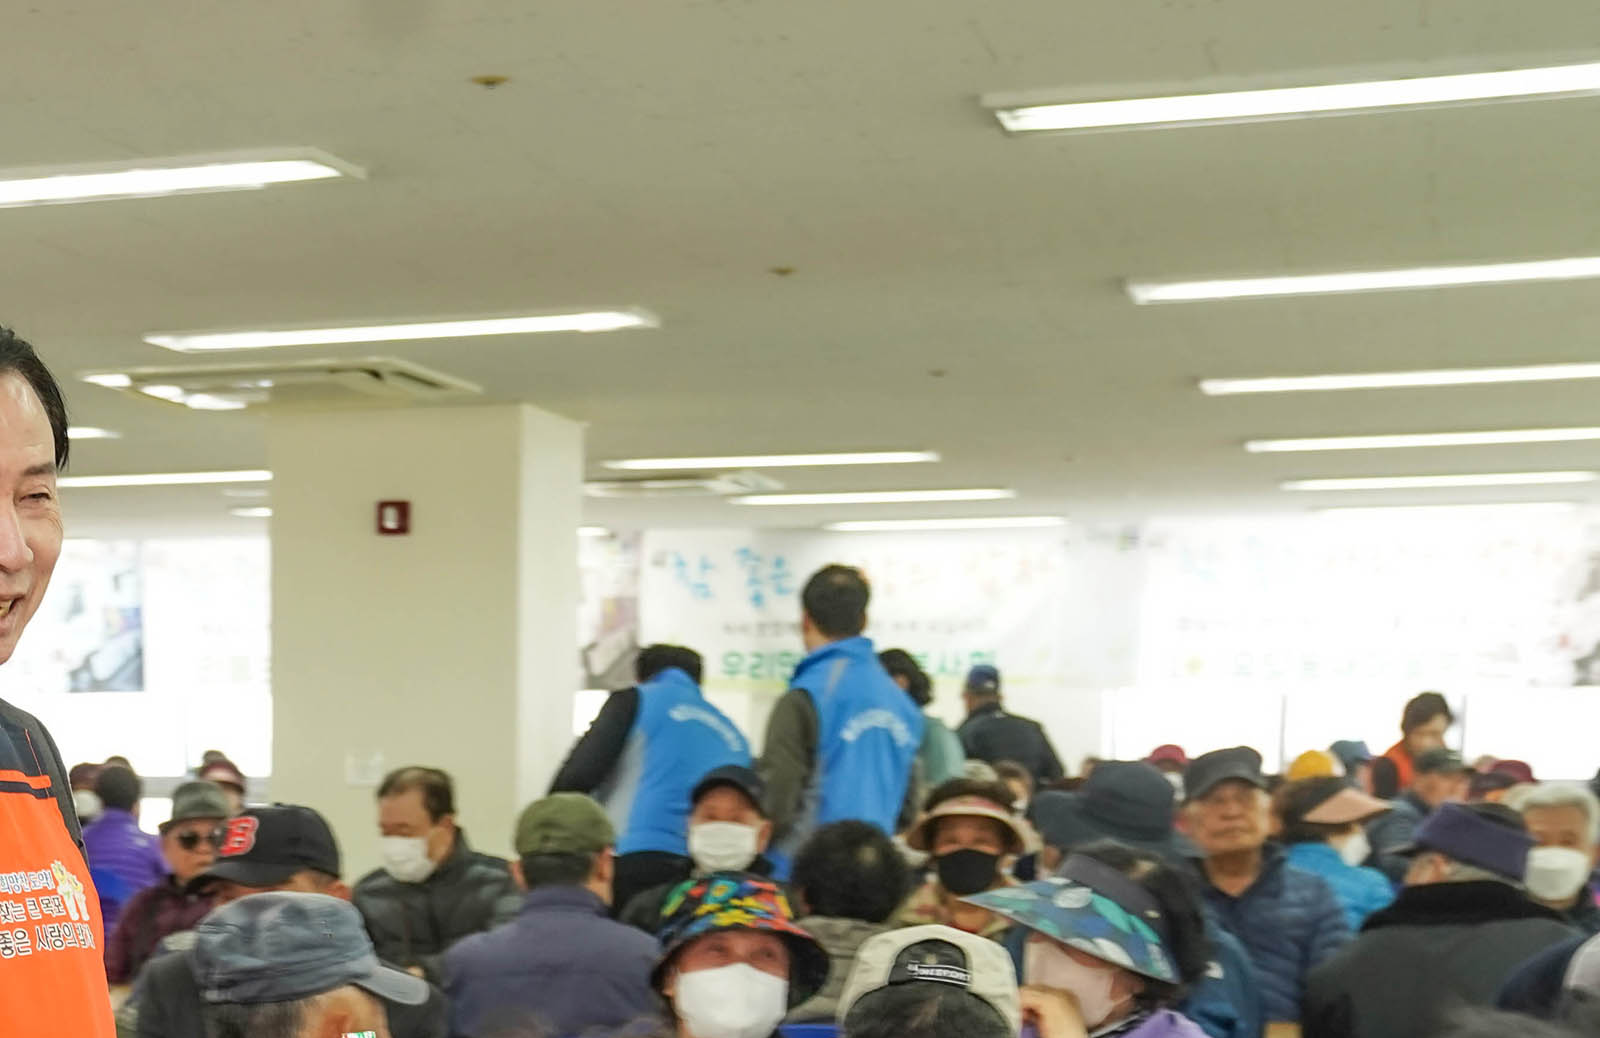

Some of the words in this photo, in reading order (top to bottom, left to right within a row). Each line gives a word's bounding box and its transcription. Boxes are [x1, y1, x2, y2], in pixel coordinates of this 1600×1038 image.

[218, 815, 260, 857] B
[25, 897, 42, 920] 큰
[41, 895, 66, 916] 목포
[34, 921, 78, 951] 사랑의
